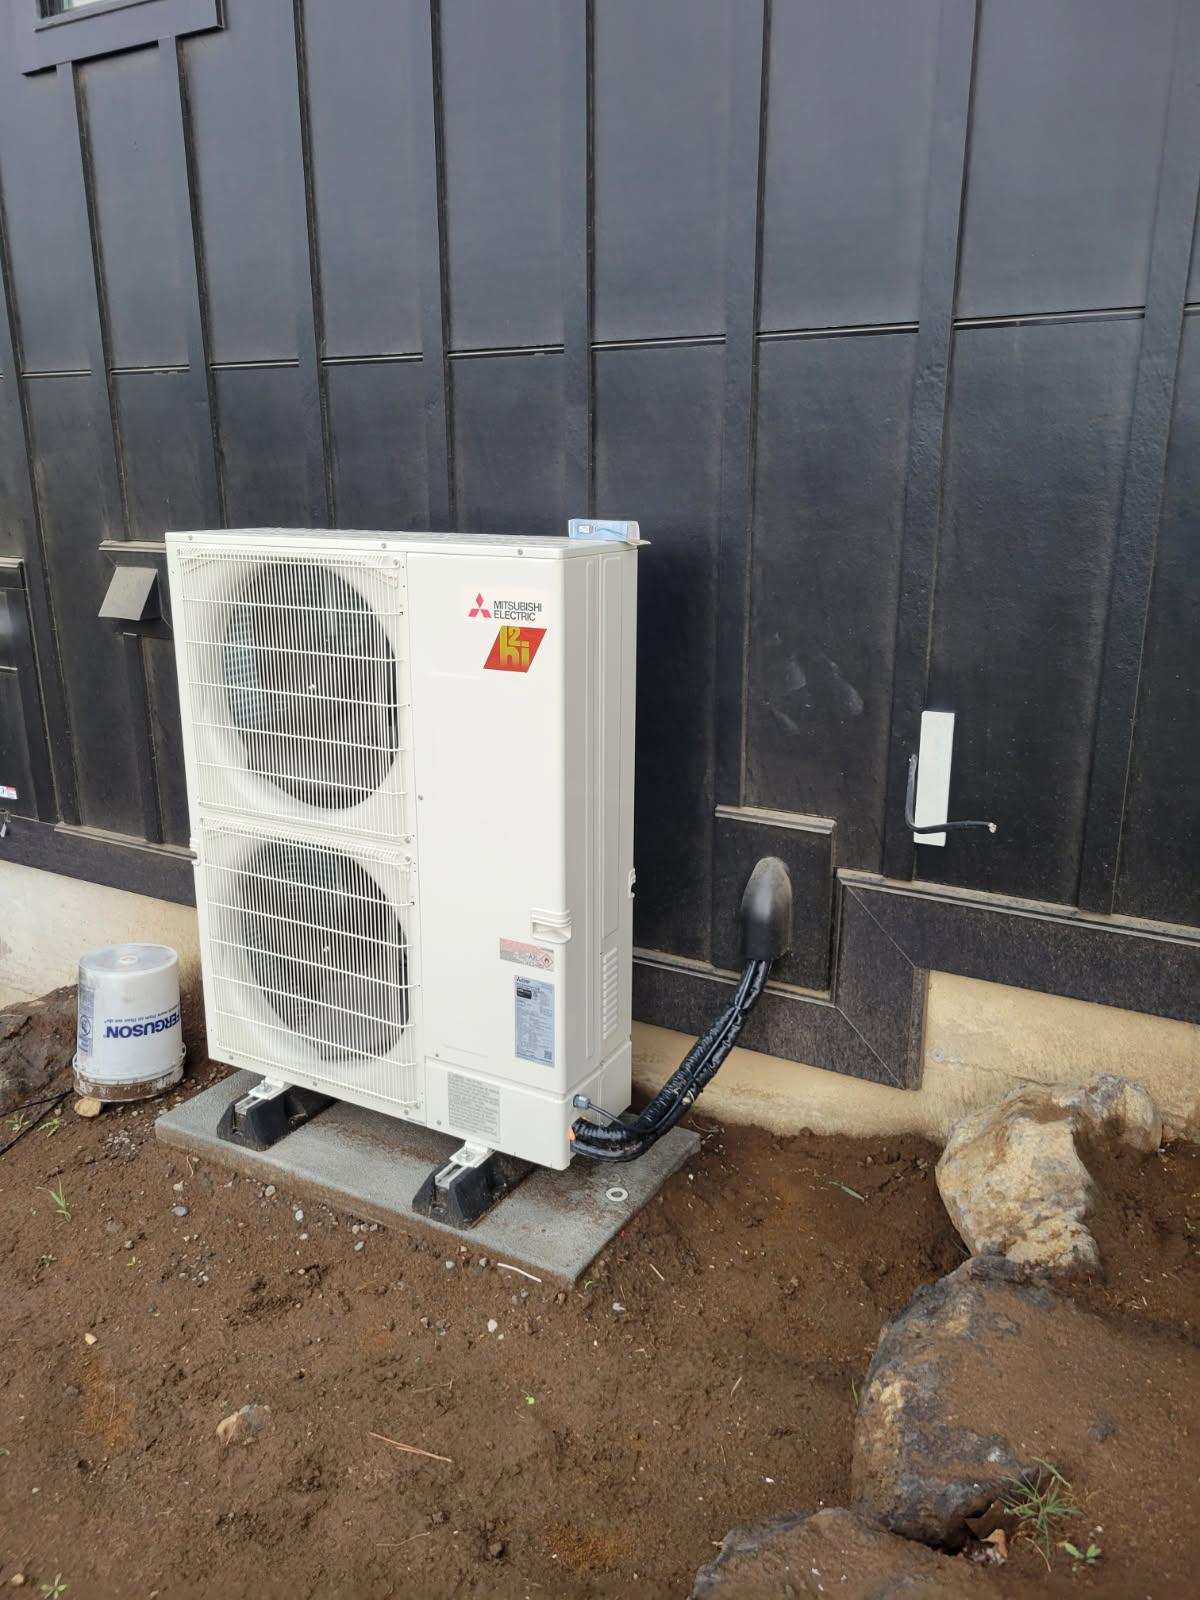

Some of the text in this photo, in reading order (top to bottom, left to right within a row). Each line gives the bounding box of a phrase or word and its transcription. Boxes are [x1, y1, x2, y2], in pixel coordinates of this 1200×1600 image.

[493, 600, 543, 612] MITSUBISHI
[493, 610, 536, 621] ELECTRIC
[106, 1012, 180, 1038] FERGUSON
